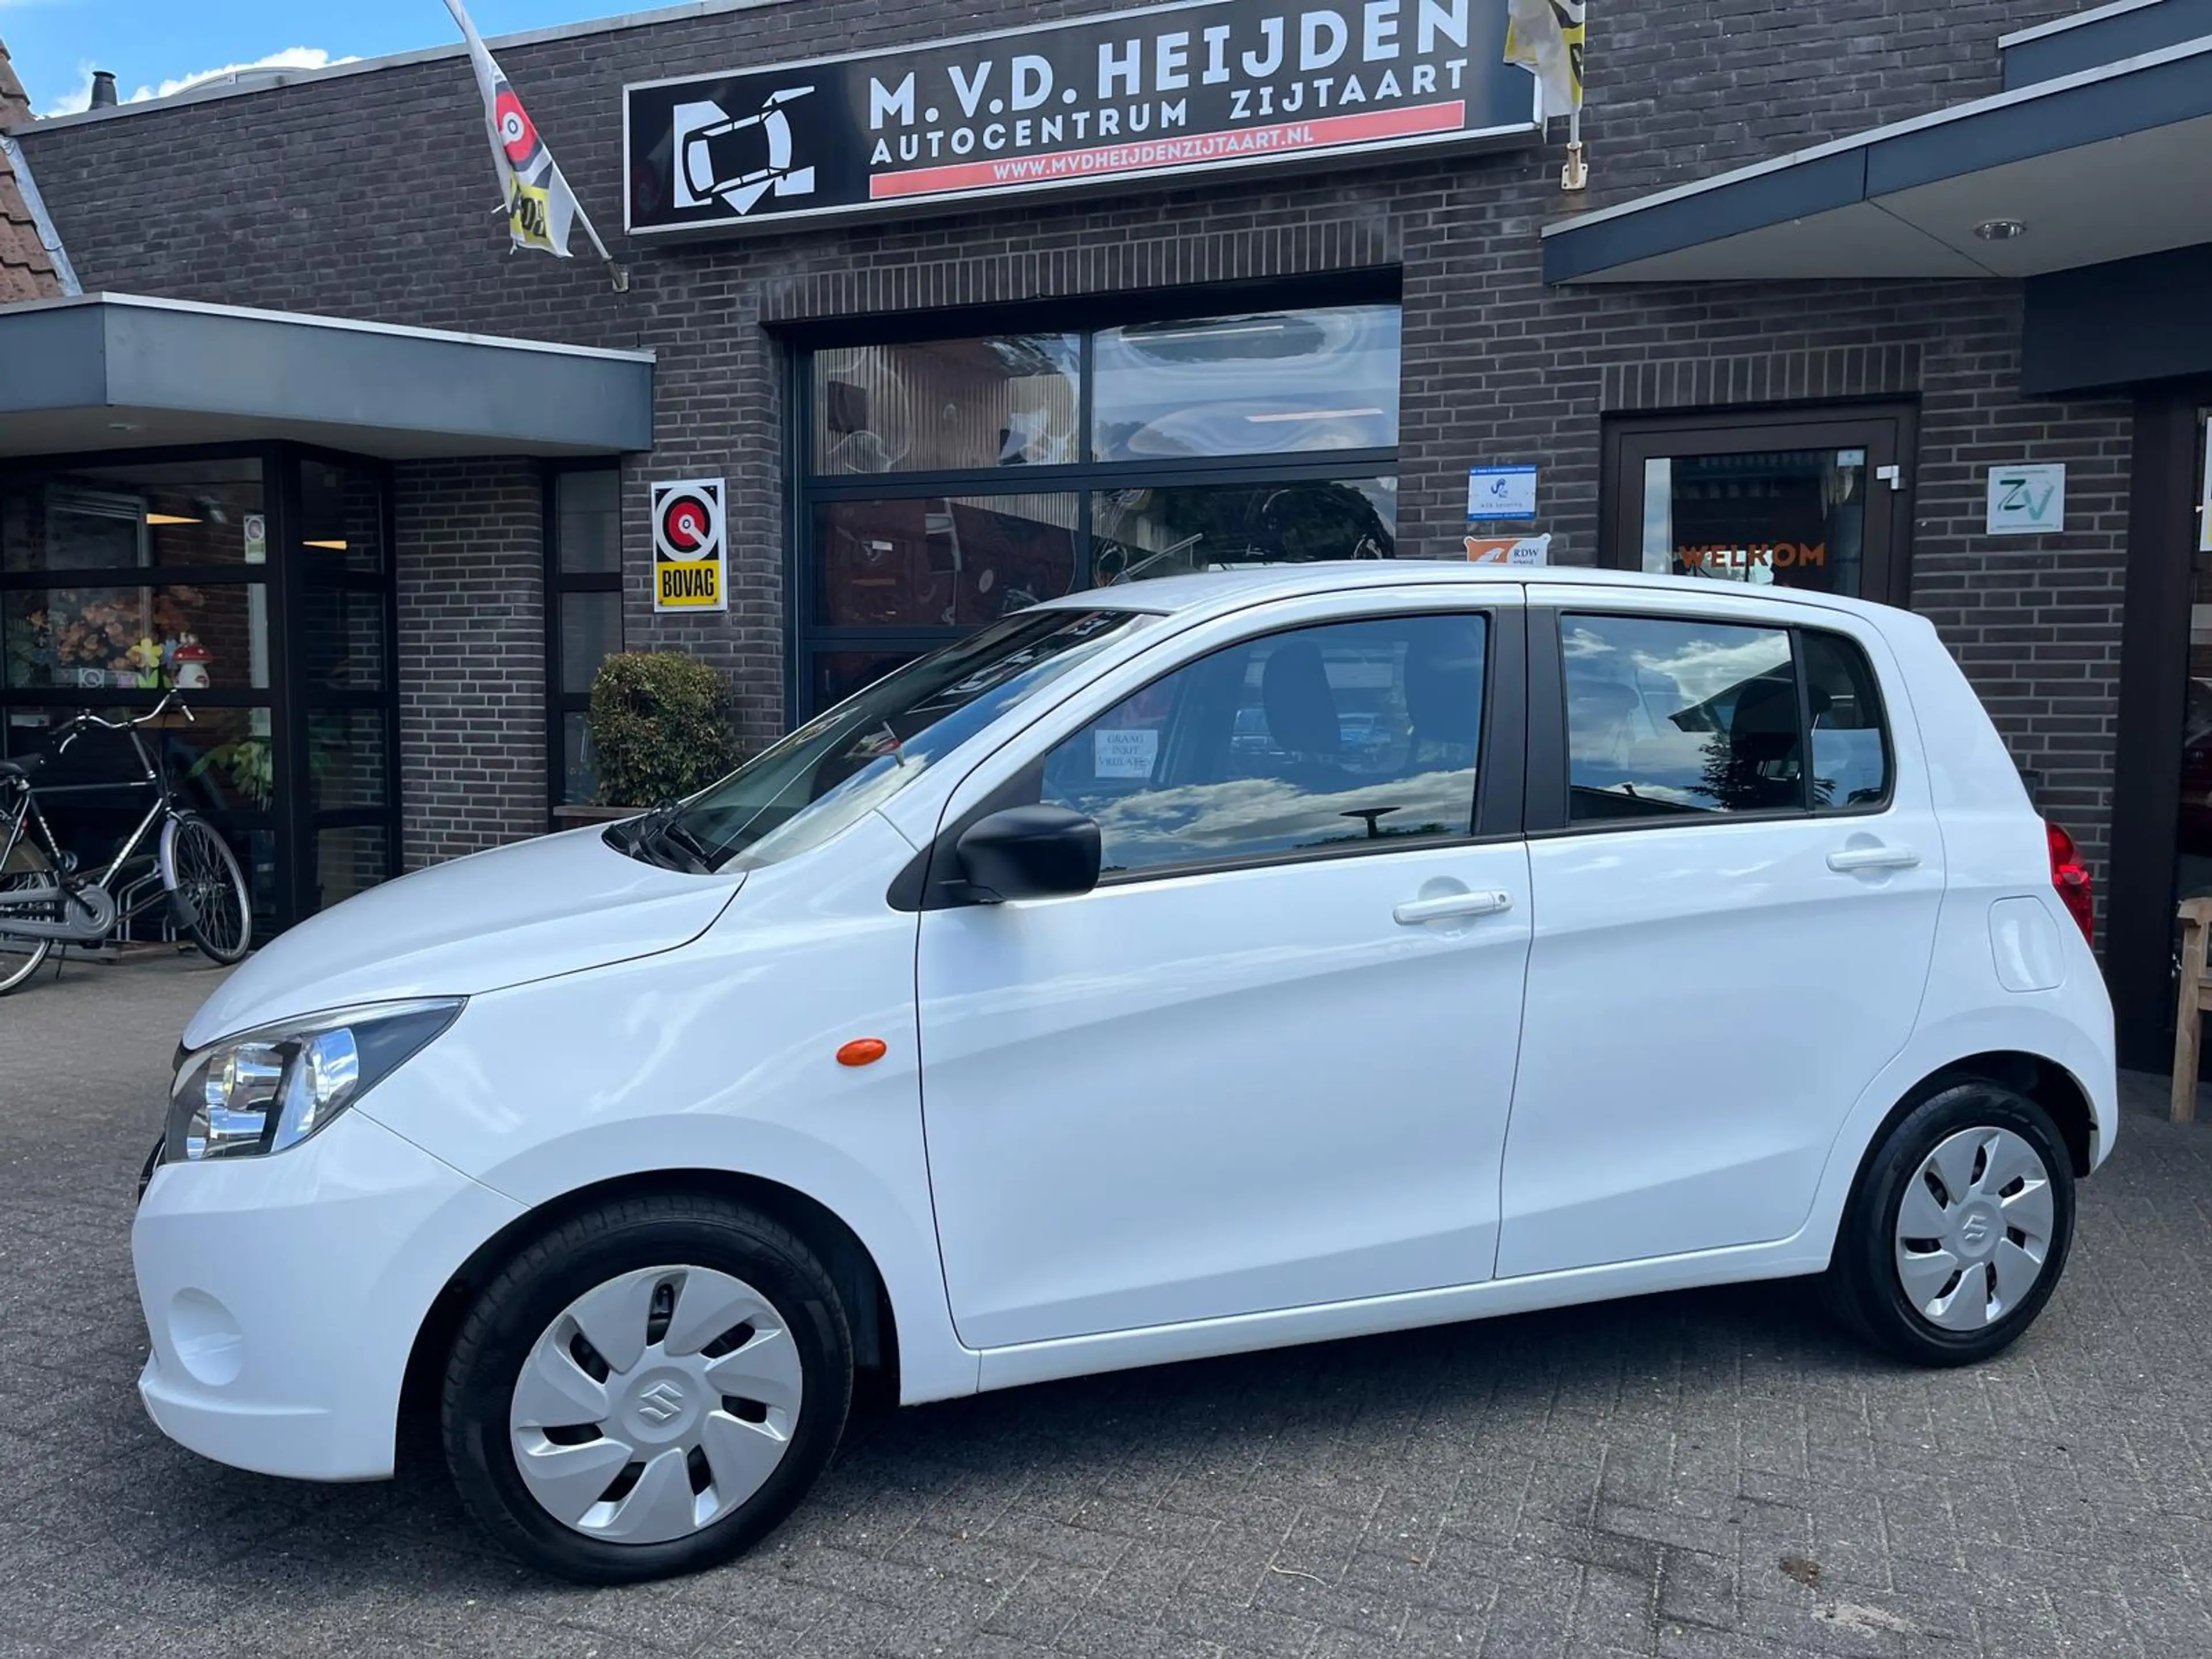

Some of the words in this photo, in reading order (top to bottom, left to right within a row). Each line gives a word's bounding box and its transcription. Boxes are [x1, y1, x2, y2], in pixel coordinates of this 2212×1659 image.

[870, 55, 1076, 129] M.V.D.
[1099, 0, 1468, 99] HEIJDEN
[870, 98, 1189, 165] AUTOCENTRUM
[1230, 59, 1468, 119] ZIJTAART
[993, 125, 1313, 180] WWW.MVDHEIJDENZIJTAART.NL
[1514, 548, 1539, 557] RDW
[1678, 542, 1825, 569] WELKOM
[662, 569, 714, 597] BOVAG
